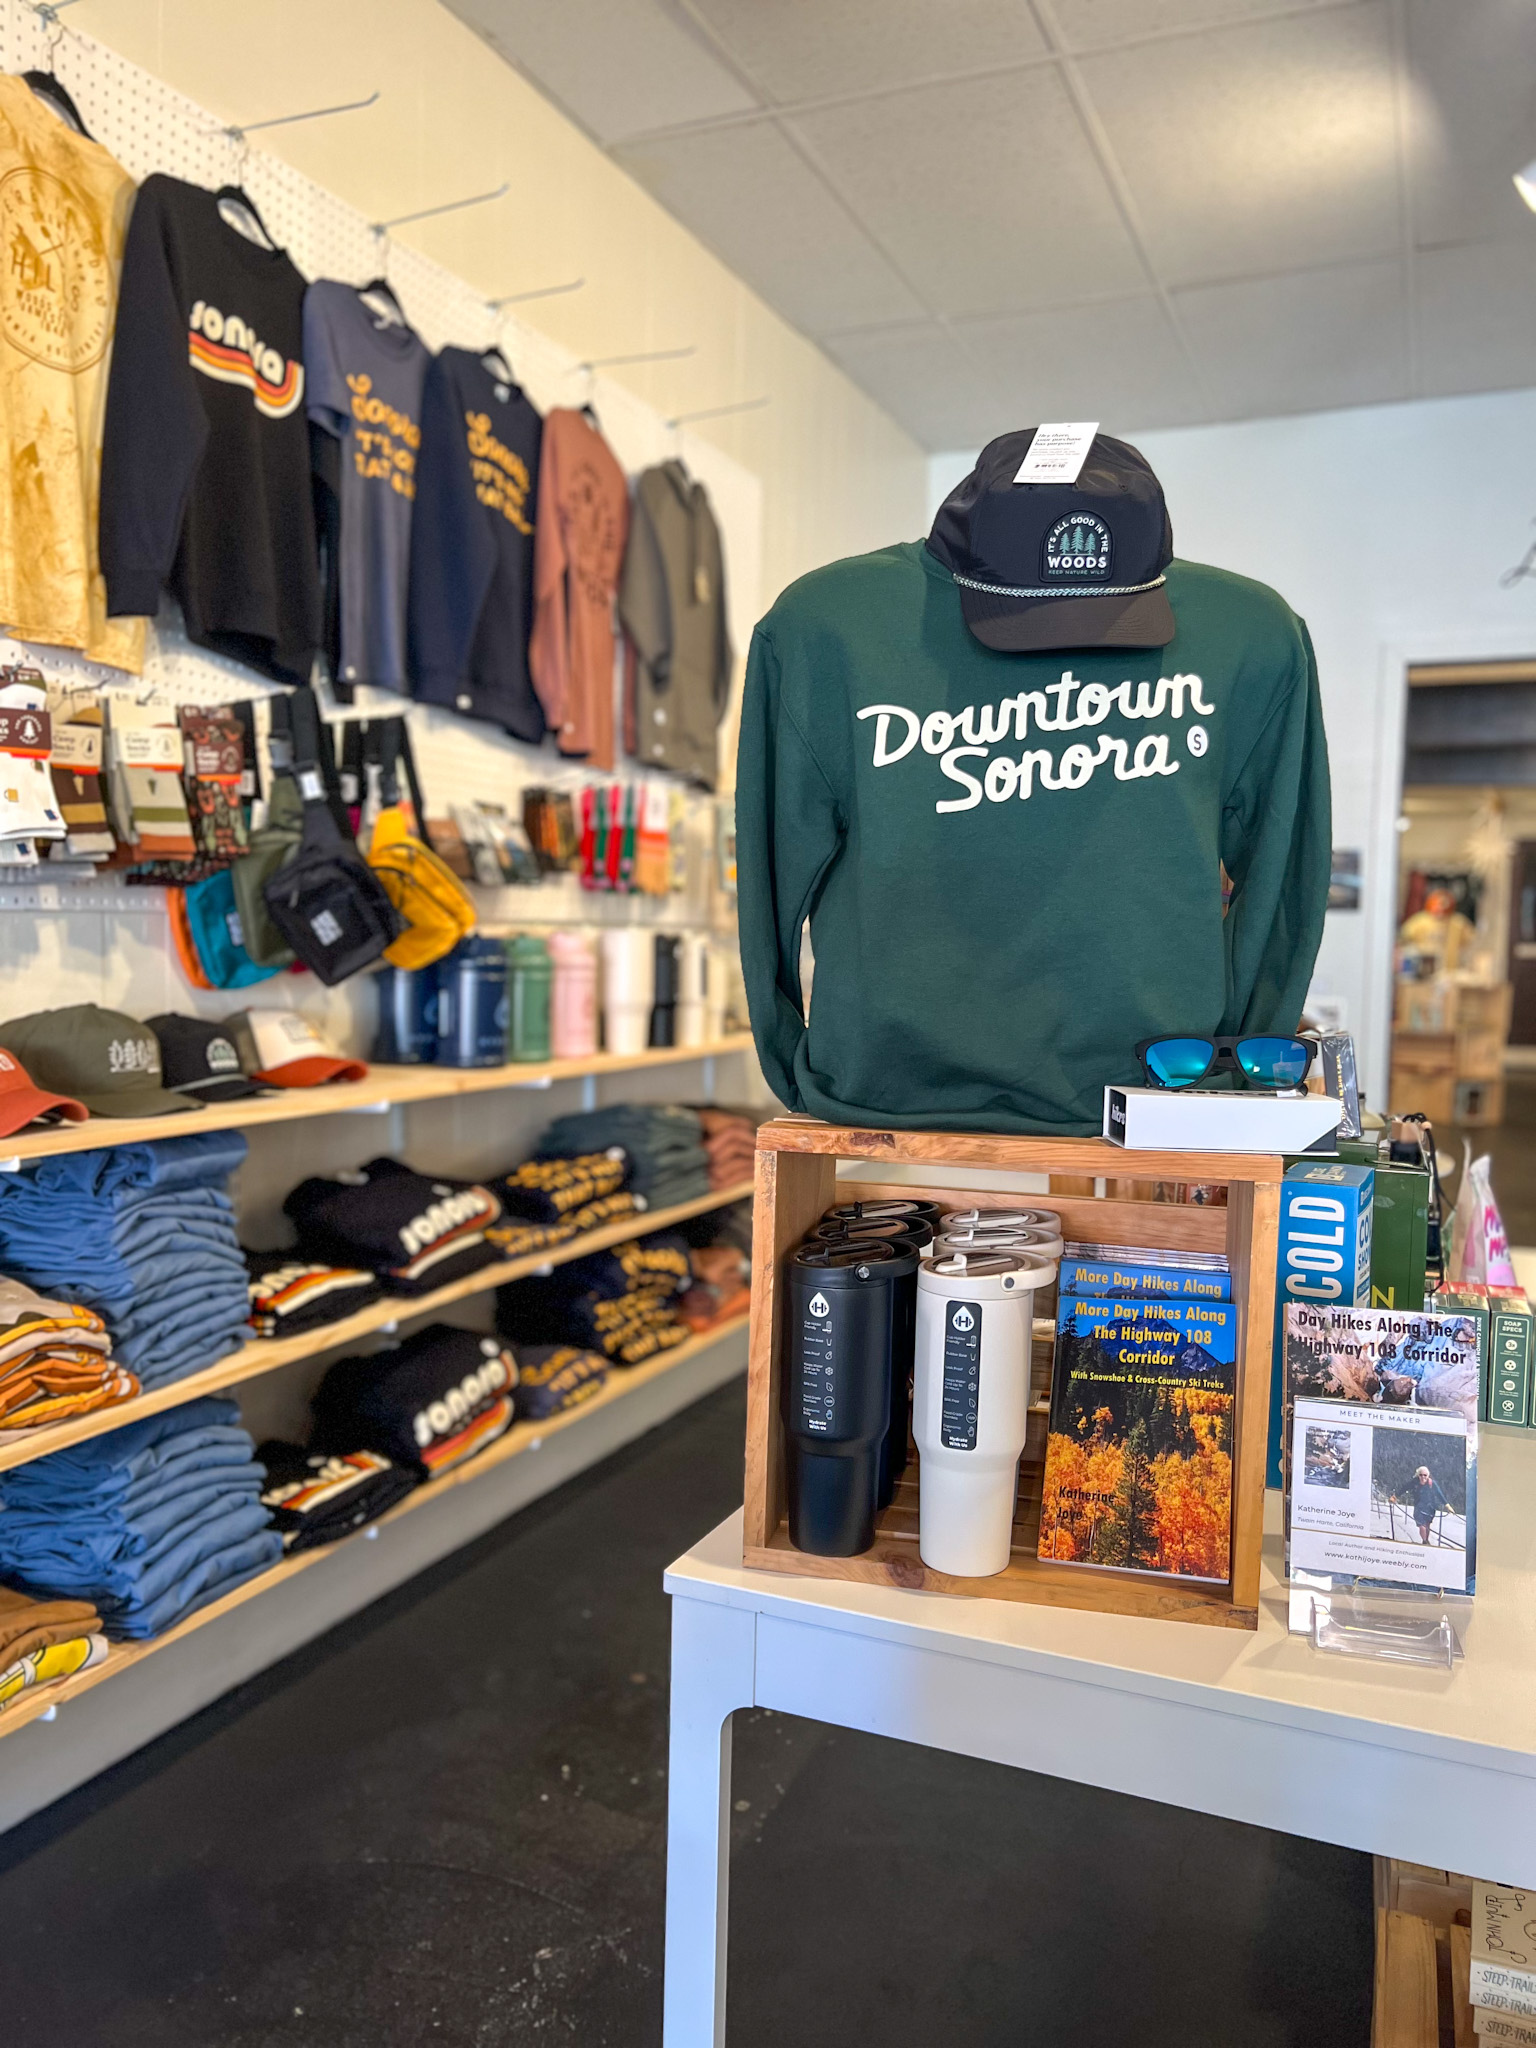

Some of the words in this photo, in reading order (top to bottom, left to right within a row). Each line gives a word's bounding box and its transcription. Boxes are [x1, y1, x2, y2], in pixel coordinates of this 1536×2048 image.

[1053, 520, 1070, 536] ALL
[1070, 516, 1095, 527] GOOD
[1094, 524, 1104, 534] IN
[1100, 533, 1109, 553] THE
[1047, 556, 1107, 569] WOODS
[856, 671, 1215, 768] Downtown
[935, 733, 1180, 814] Sonora
[1286, 1196, 1345, 1299] COLD
[1074, 1268, 1109, 1284] More
[1113, 1271, 1138, 1290] Day
[1142, 1275, 1179, 1292] Hikes
[1183, 1279, 1222, 1299] Along
[1074, 1302, 1109, 1318] More
[1113, 1304, 1139, 1322] Day
[1143, 1305, 1181, 1320] Hikes
[1185, 1307, 1226, 1326] Along
[1298, 1311, 1325, 1330] Day
[1331, 1313, 1372, 1331] Hikes
[1377, 1319, 1421, 1339] Along
[1427, 1320, 1453, 1338] The
[1094, 1325, 1117, 1340] The
[1121, 1326, 1180, 1346] Highway
[1186, 1329, 1212, 1345] 108
[1118, 1349, 1176, 1366] Corridor
[1297, 1337, 1363, 1359] Highway
[1370, 1341, 1397, 1359] 108
[1403, 1345, 1467, 1365] Corridor
[1070, 1370, 1088, 1380] With
[1089, 1372, 1126, 1383] Snowshoe
[1127, 1373, 1133, 1383] &
[1135, 1374, 1187, 1388] Cross-Country
[1188, 1377, 1201, 1387] Ski
[1203, 1379, 1224, 1389] Treks
[1339, 1409, 1363, 1418] MEET
[1367, 1413, 1384, 1421] THE
[1389, 1415, 1421, 1424] MAKER
[1058, 1486, 1116, 1503] Katherine
[1056, 1506, 1083, 1520] Joye
[1297, 1505, 1336, 1516] Katherine
[1337, 1509, 1356, 1519] Joye
[1296, 1516, 1315, 1524] Twain
[1335, 1521, 1364, 1530] California
[1344, 1542, 1363, 1550] Author
[1376, 1546, 1394, 1554] Hiking
[1395, 1549, 1425, 1558] Enthusiast
[1511, 1976, 1536, 1993] TRAIL
[1510, 1999, 1536, 2015] TRAIL
